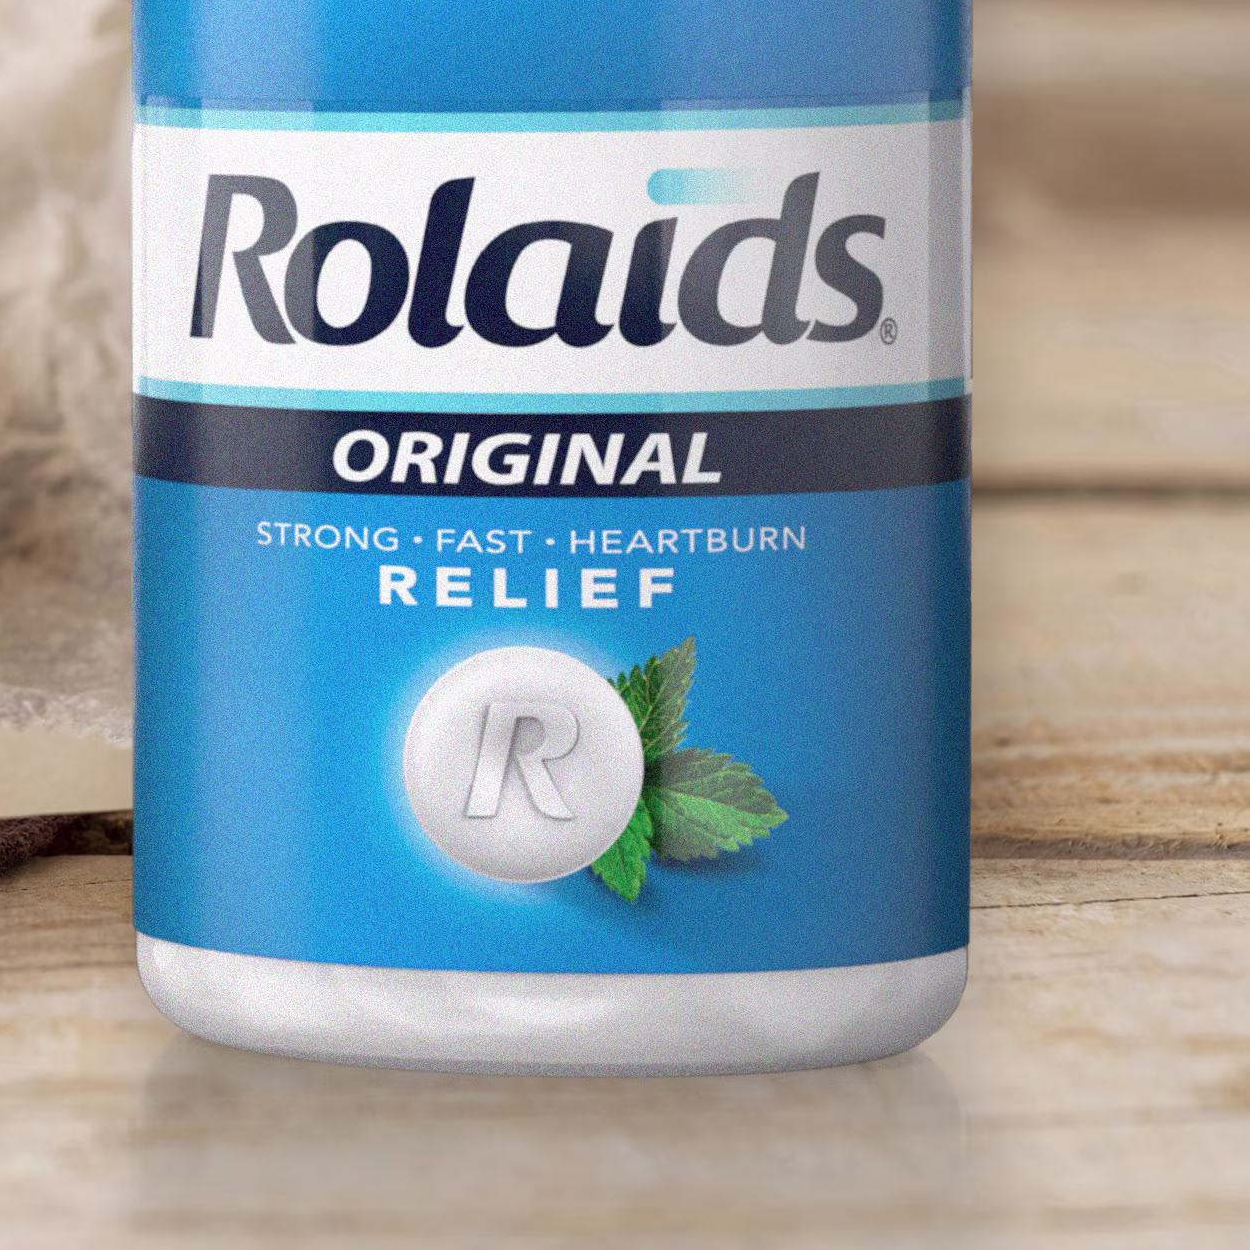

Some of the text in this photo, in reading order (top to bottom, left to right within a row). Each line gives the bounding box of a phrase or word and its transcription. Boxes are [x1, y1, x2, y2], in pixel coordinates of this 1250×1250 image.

[332, 429, 723, 486] ORIGINAL
[256, 520, 807, 556] STRONG FAST HEARTBURN
[378, 565, 676, 609] RELIEF
[463, 702, 580, 821] R
